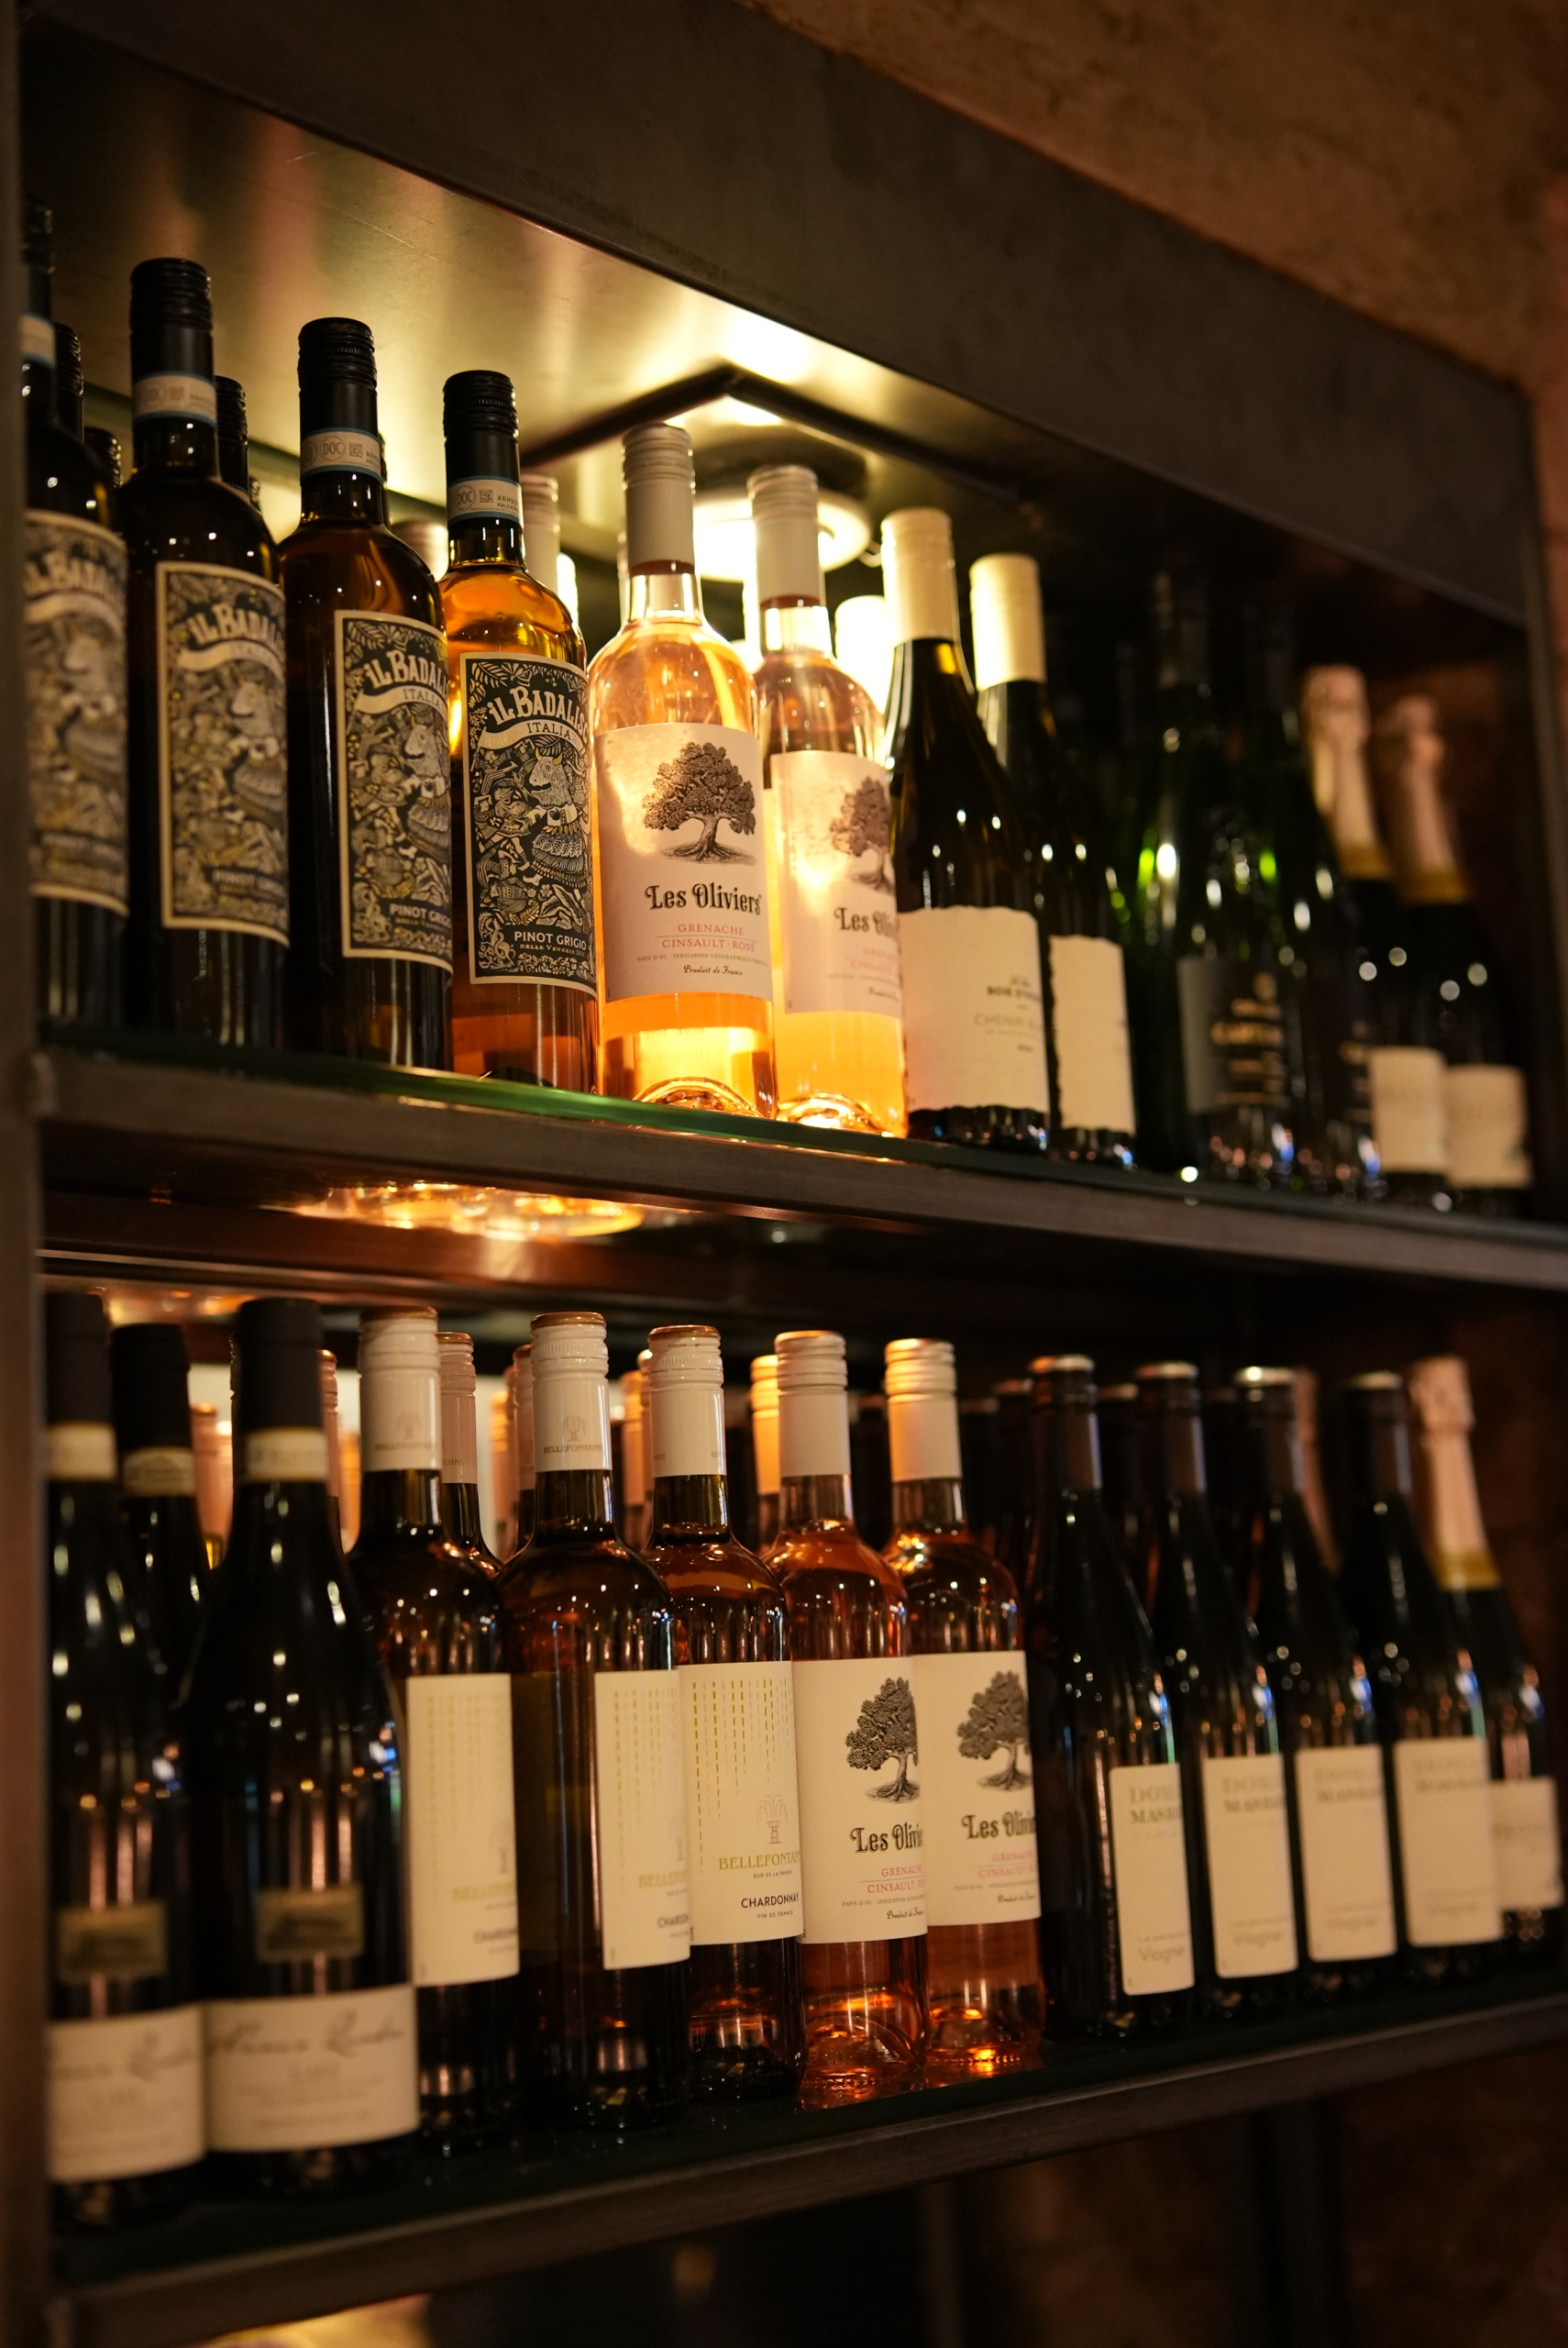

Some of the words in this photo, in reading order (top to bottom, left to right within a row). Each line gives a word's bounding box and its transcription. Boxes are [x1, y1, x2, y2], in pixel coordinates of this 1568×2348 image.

[323, 442, 342, 456] DOC
[457, 491, 472, 505] DOC
[403, 688, 442, 711] ITALIA
[526, 723, 571, 740] ITALIA
[645, 885, 687, 910] Les
[691, 881, 762, 915] Oliviers
[390, 903, 427, 919] PINOT
[834, 906, 870, 933] Les
[678, 924, 745, 936] GRENACHE
[514, 931, 554, 943] PINOT
[557, 935, 586, 950] GRIGIO
[662, 938, 725, 948] CINSAULT
[547, 945, 575, 954] VENEZIE
[683, 965, 711, 974] Produit
[722, 966, 743, 976] France
[961, 1814, 999, 1840] Les
[849, 1827, 889, 1854] Les
[867, 1881, 915, 1894] CINSAULT
[741, 1892, 799, 1909] CHARDONNAY
[877, 1897, 906, 1905] INDICATION
[886, 1911, 907, 1920] Produit
